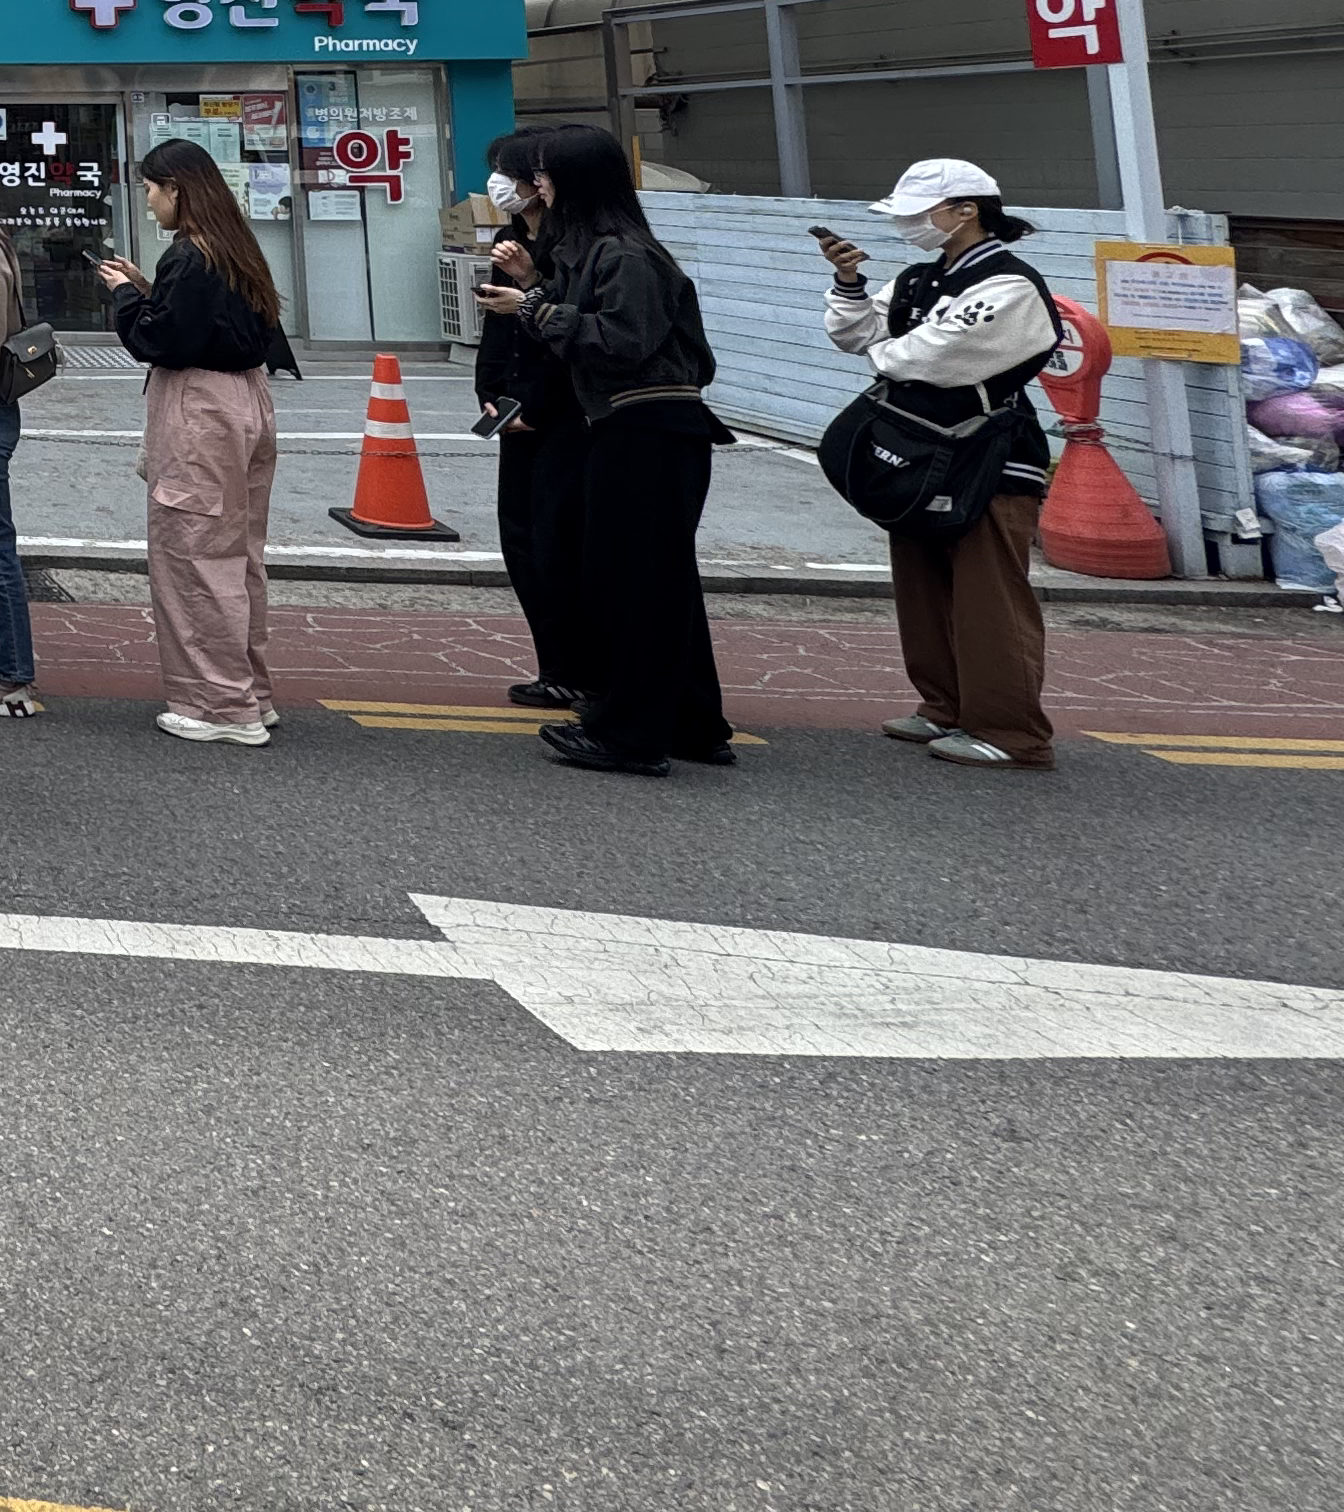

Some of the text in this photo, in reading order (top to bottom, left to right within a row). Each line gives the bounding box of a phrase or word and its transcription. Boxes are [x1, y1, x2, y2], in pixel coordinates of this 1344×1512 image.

[313, 35, 419, 55] Pharmacy
[334, 127, 414, 204] 약
[49, 188, 102, 199] Pharmacy
